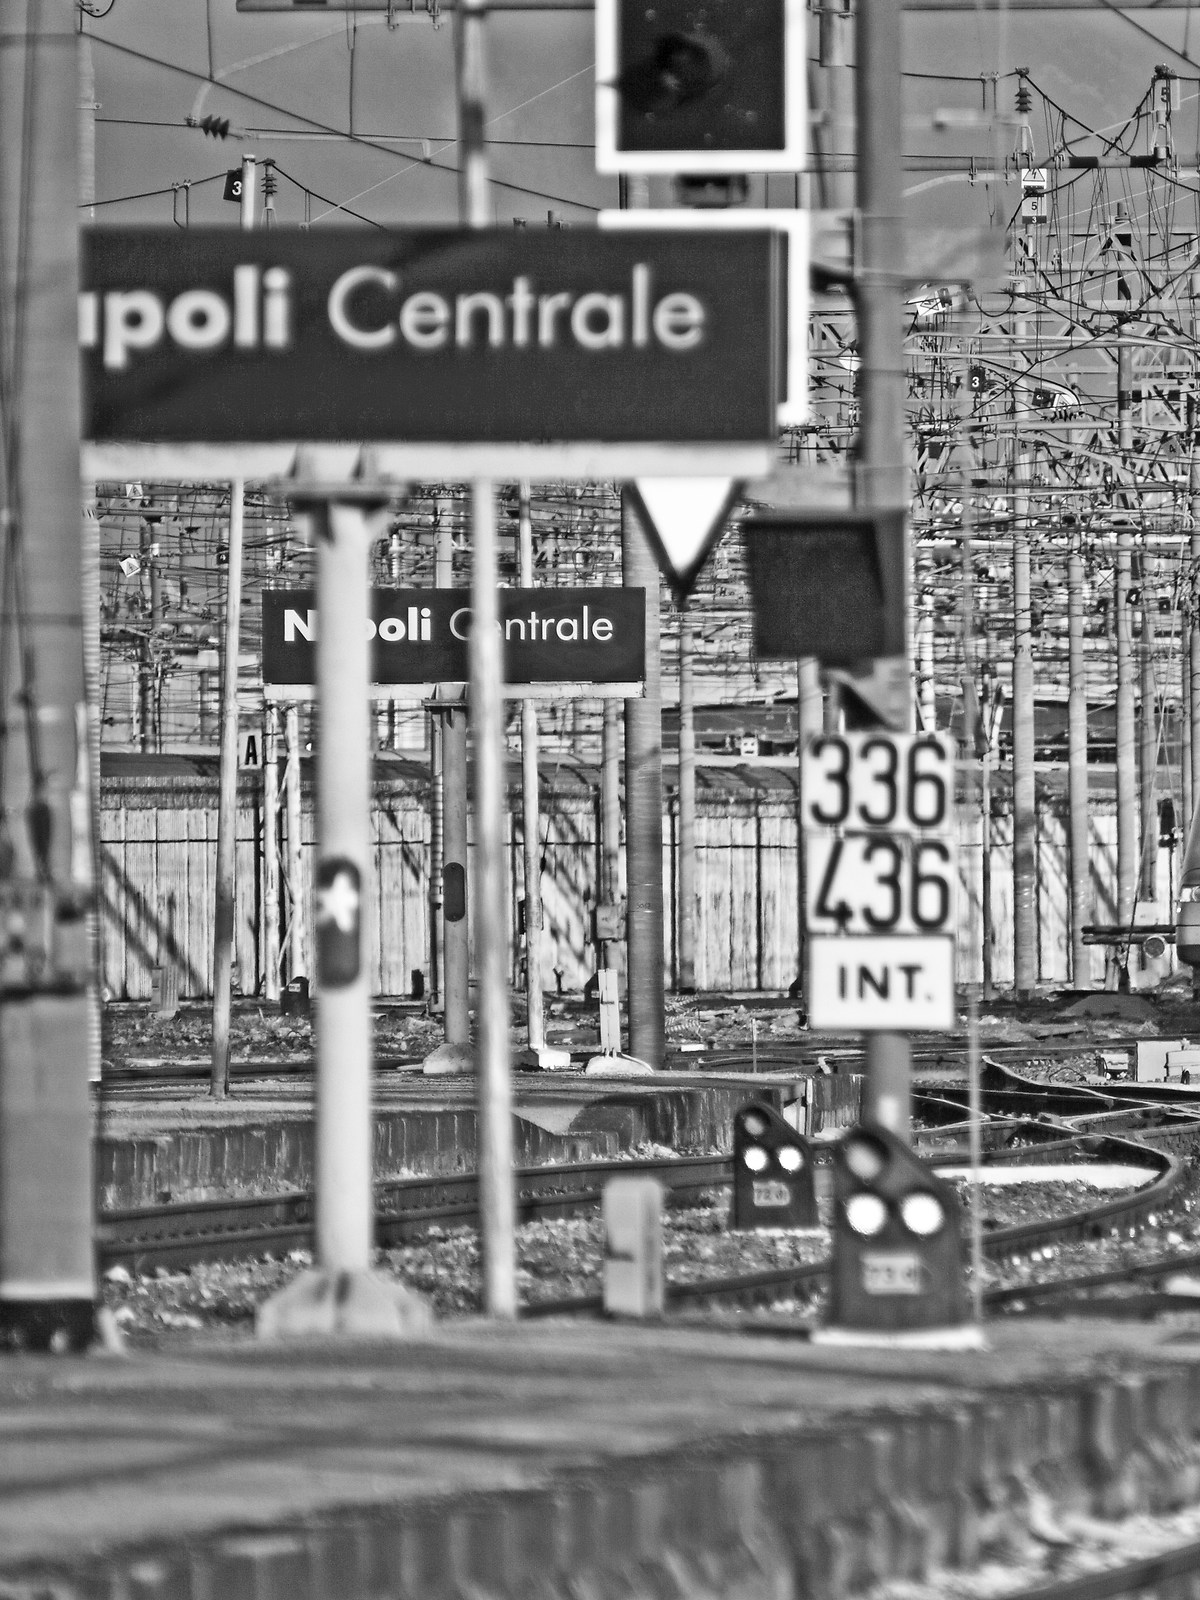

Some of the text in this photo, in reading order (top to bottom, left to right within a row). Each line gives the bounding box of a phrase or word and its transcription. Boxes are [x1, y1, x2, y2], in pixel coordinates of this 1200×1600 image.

[231, 180, 242, 196] 3
[1031, 201, 1038, 211] 5
[1031, 216, 1037, 224] 3
[78, 262, 704, 370] poli Centrale
[971, 376, 980, 388] 3
[1169, 444, 1176, 453] 4
[450, 605, 614, 642] Cntrale
[245, 735, 258, 765] A
[810, 737, 948, 827] 336
[814, 838, 951, 930] 436
[838, 965, 936, 1000] INT.
